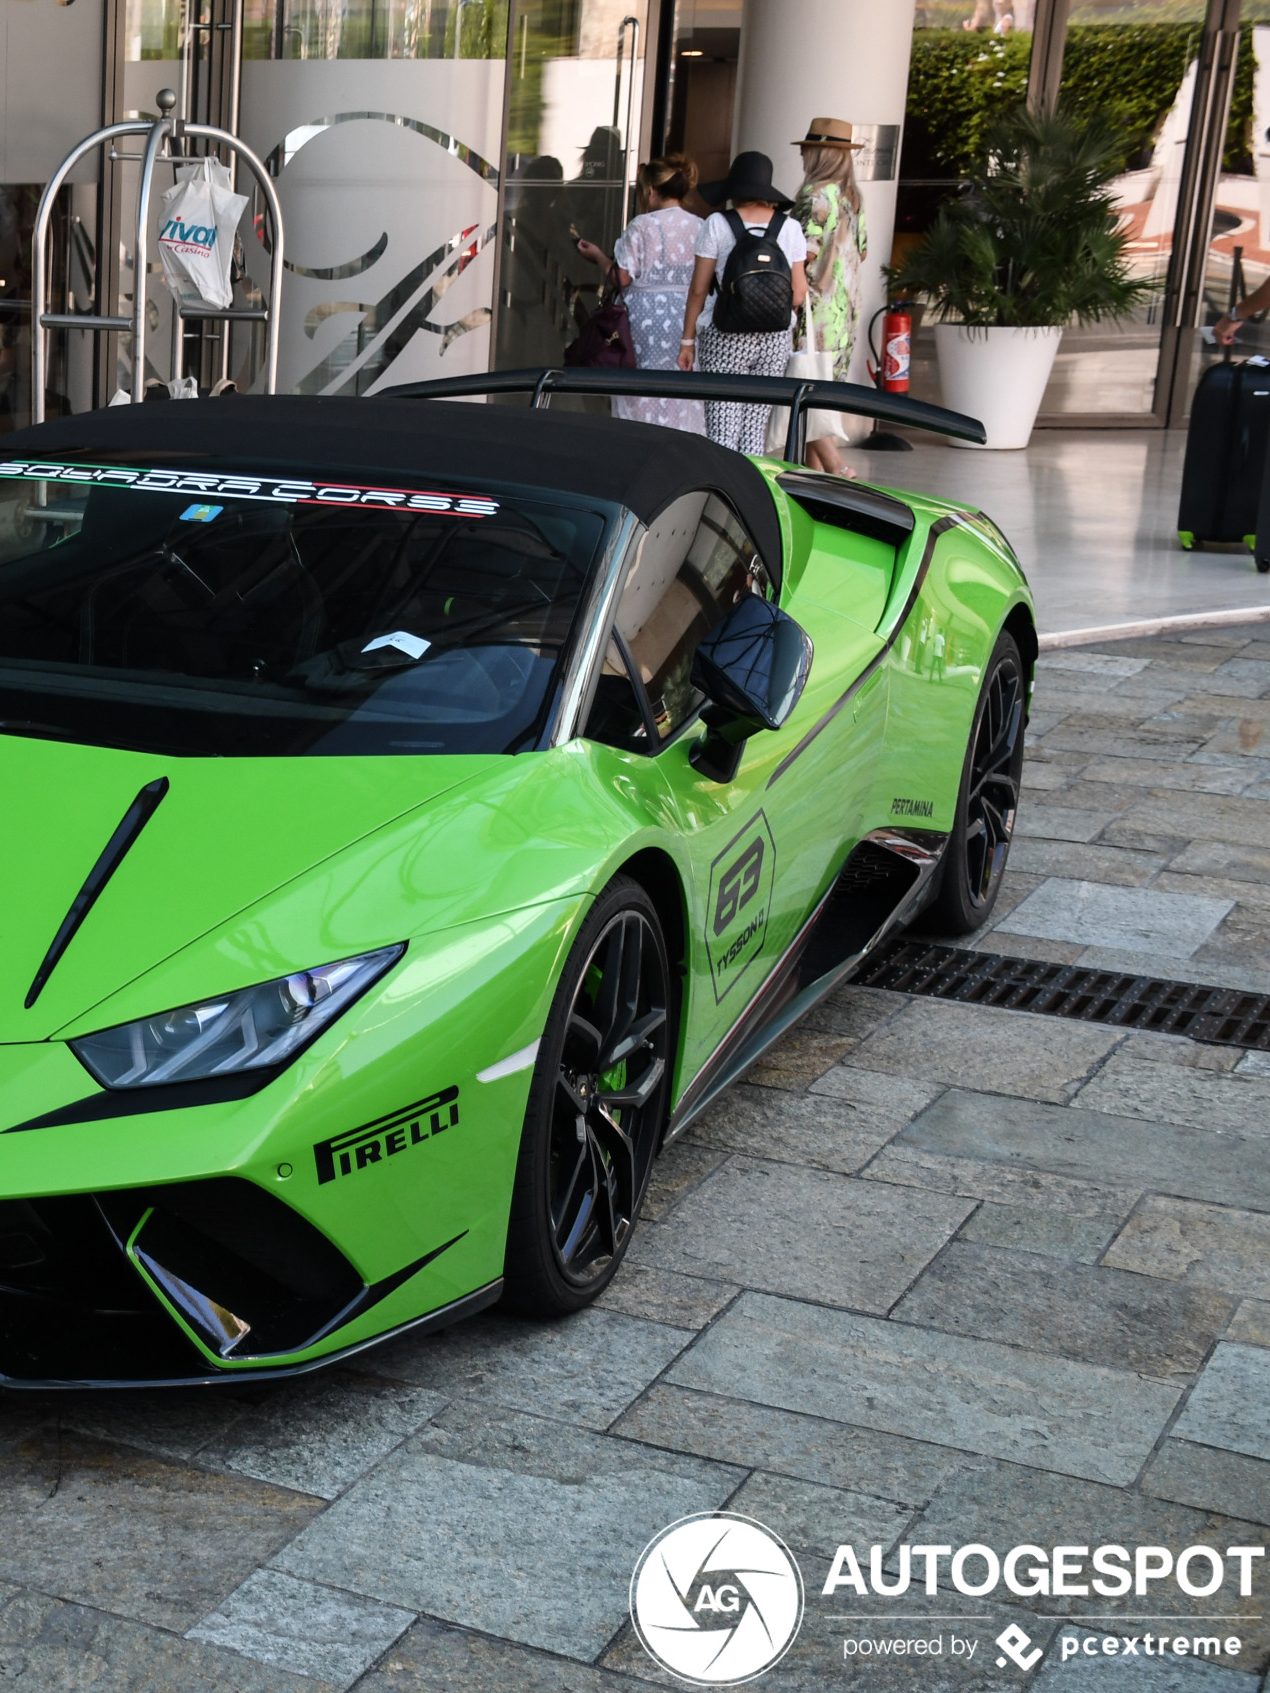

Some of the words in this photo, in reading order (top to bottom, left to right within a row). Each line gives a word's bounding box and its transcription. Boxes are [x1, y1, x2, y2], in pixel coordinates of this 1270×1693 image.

[174, 245, 210, 259] Casino
[272, 484, 500, 516] CORSE
[890, 798, 934, 818] PERTAMINA
[713, 835, 765, 937] 63
[717, 915, 759, 977] TYSSON
[313, 1084, 459, 1186] PIRELLI
